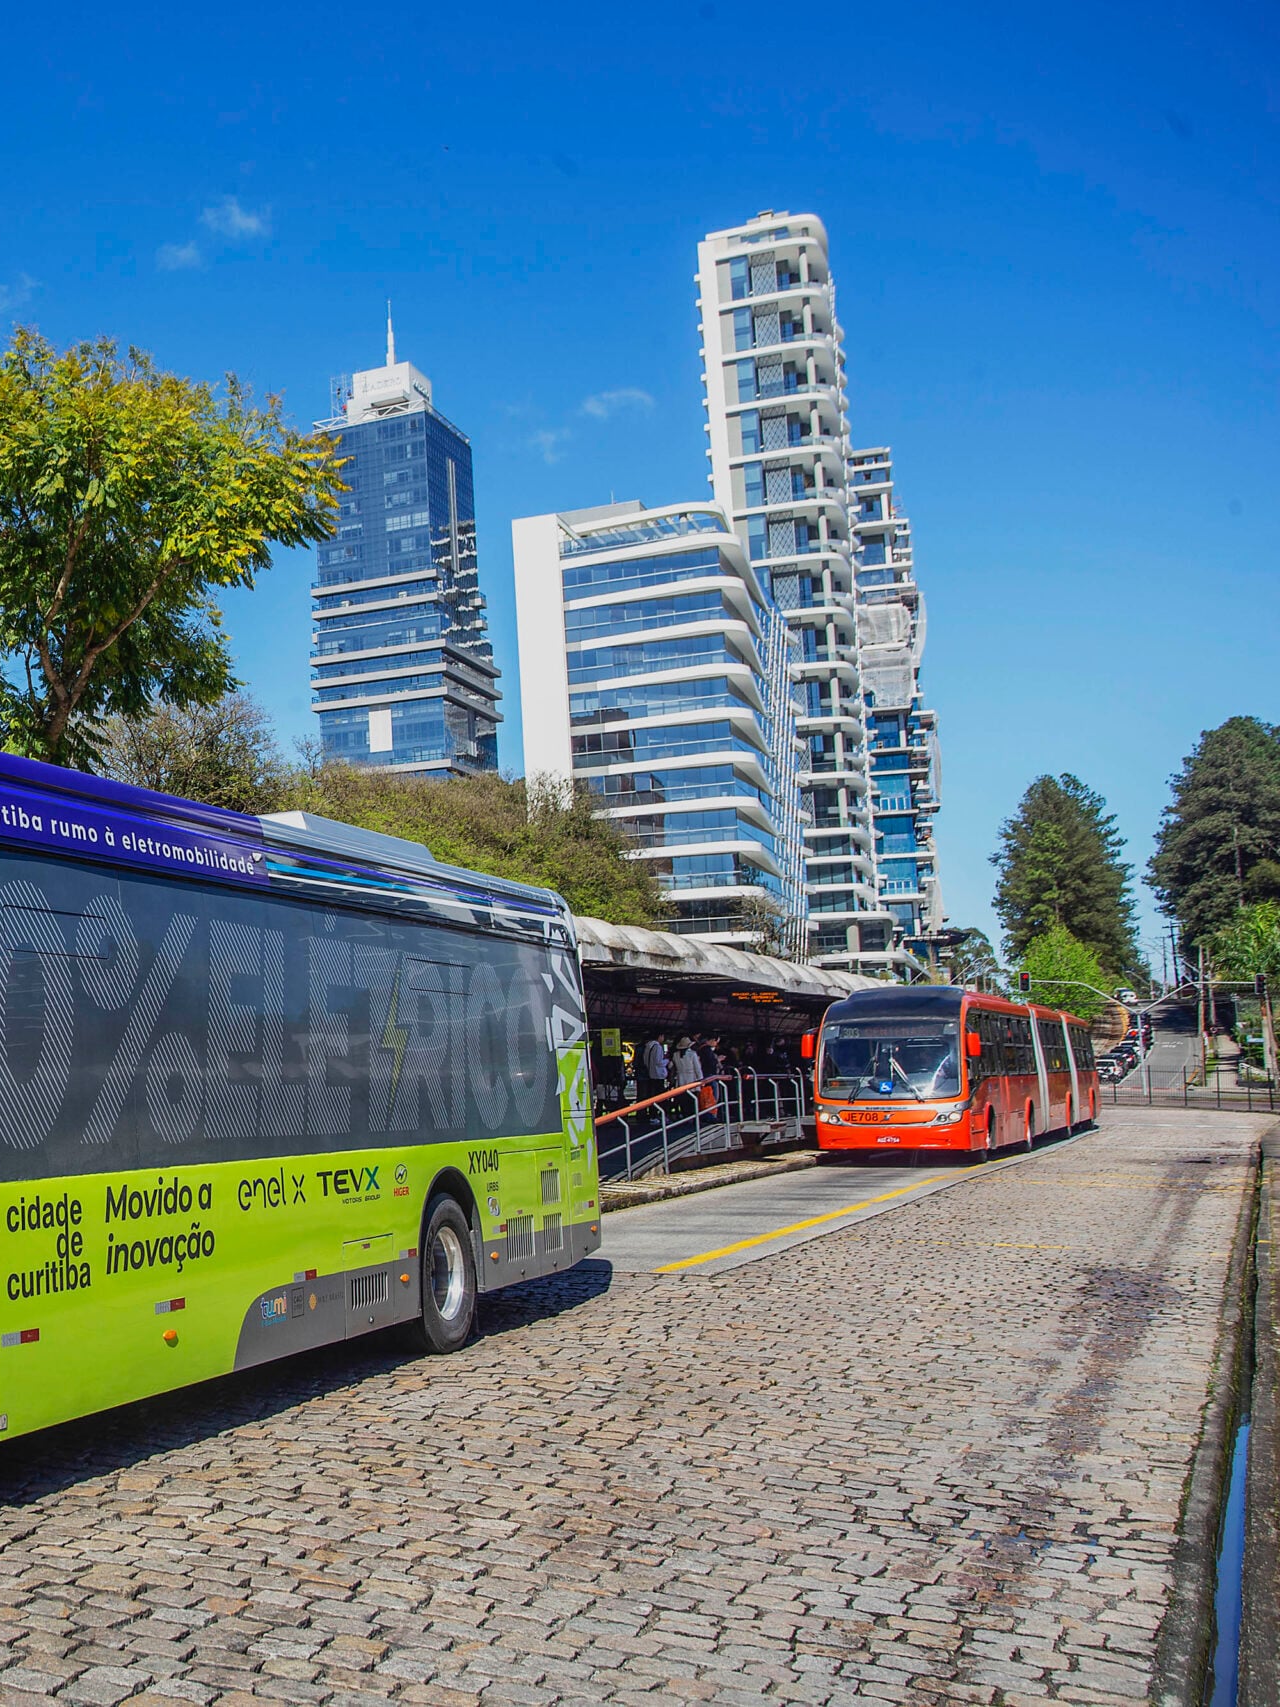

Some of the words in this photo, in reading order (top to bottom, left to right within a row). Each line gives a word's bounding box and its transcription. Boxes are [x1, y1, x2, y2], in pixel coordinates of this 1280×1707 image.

[50, 818, 99, 844] rumo
[104, 825, 116, 847] à
[122, 832, 256, 876] eletromobilidade
[844, 1111, 879, 1122] JE708
[467, 1149, 499, 1175] XY040
[238, 1167, 287, 1212] enel
[316, 1165, 381, 1197] TEVX
[393, 1186, 410, 1198] HIGER
[6, 1193, 83, 1233] cidade
[104, 1176, 194, 1223] Movido
[198, 1182, 213, 1211] a
[56, 1230, 84, 1259] de
[105, 1222, 216, 1275] inovação
[6, 1258, 92, 1301] curitiba
[260, 1290, 287, 1320] tumi
